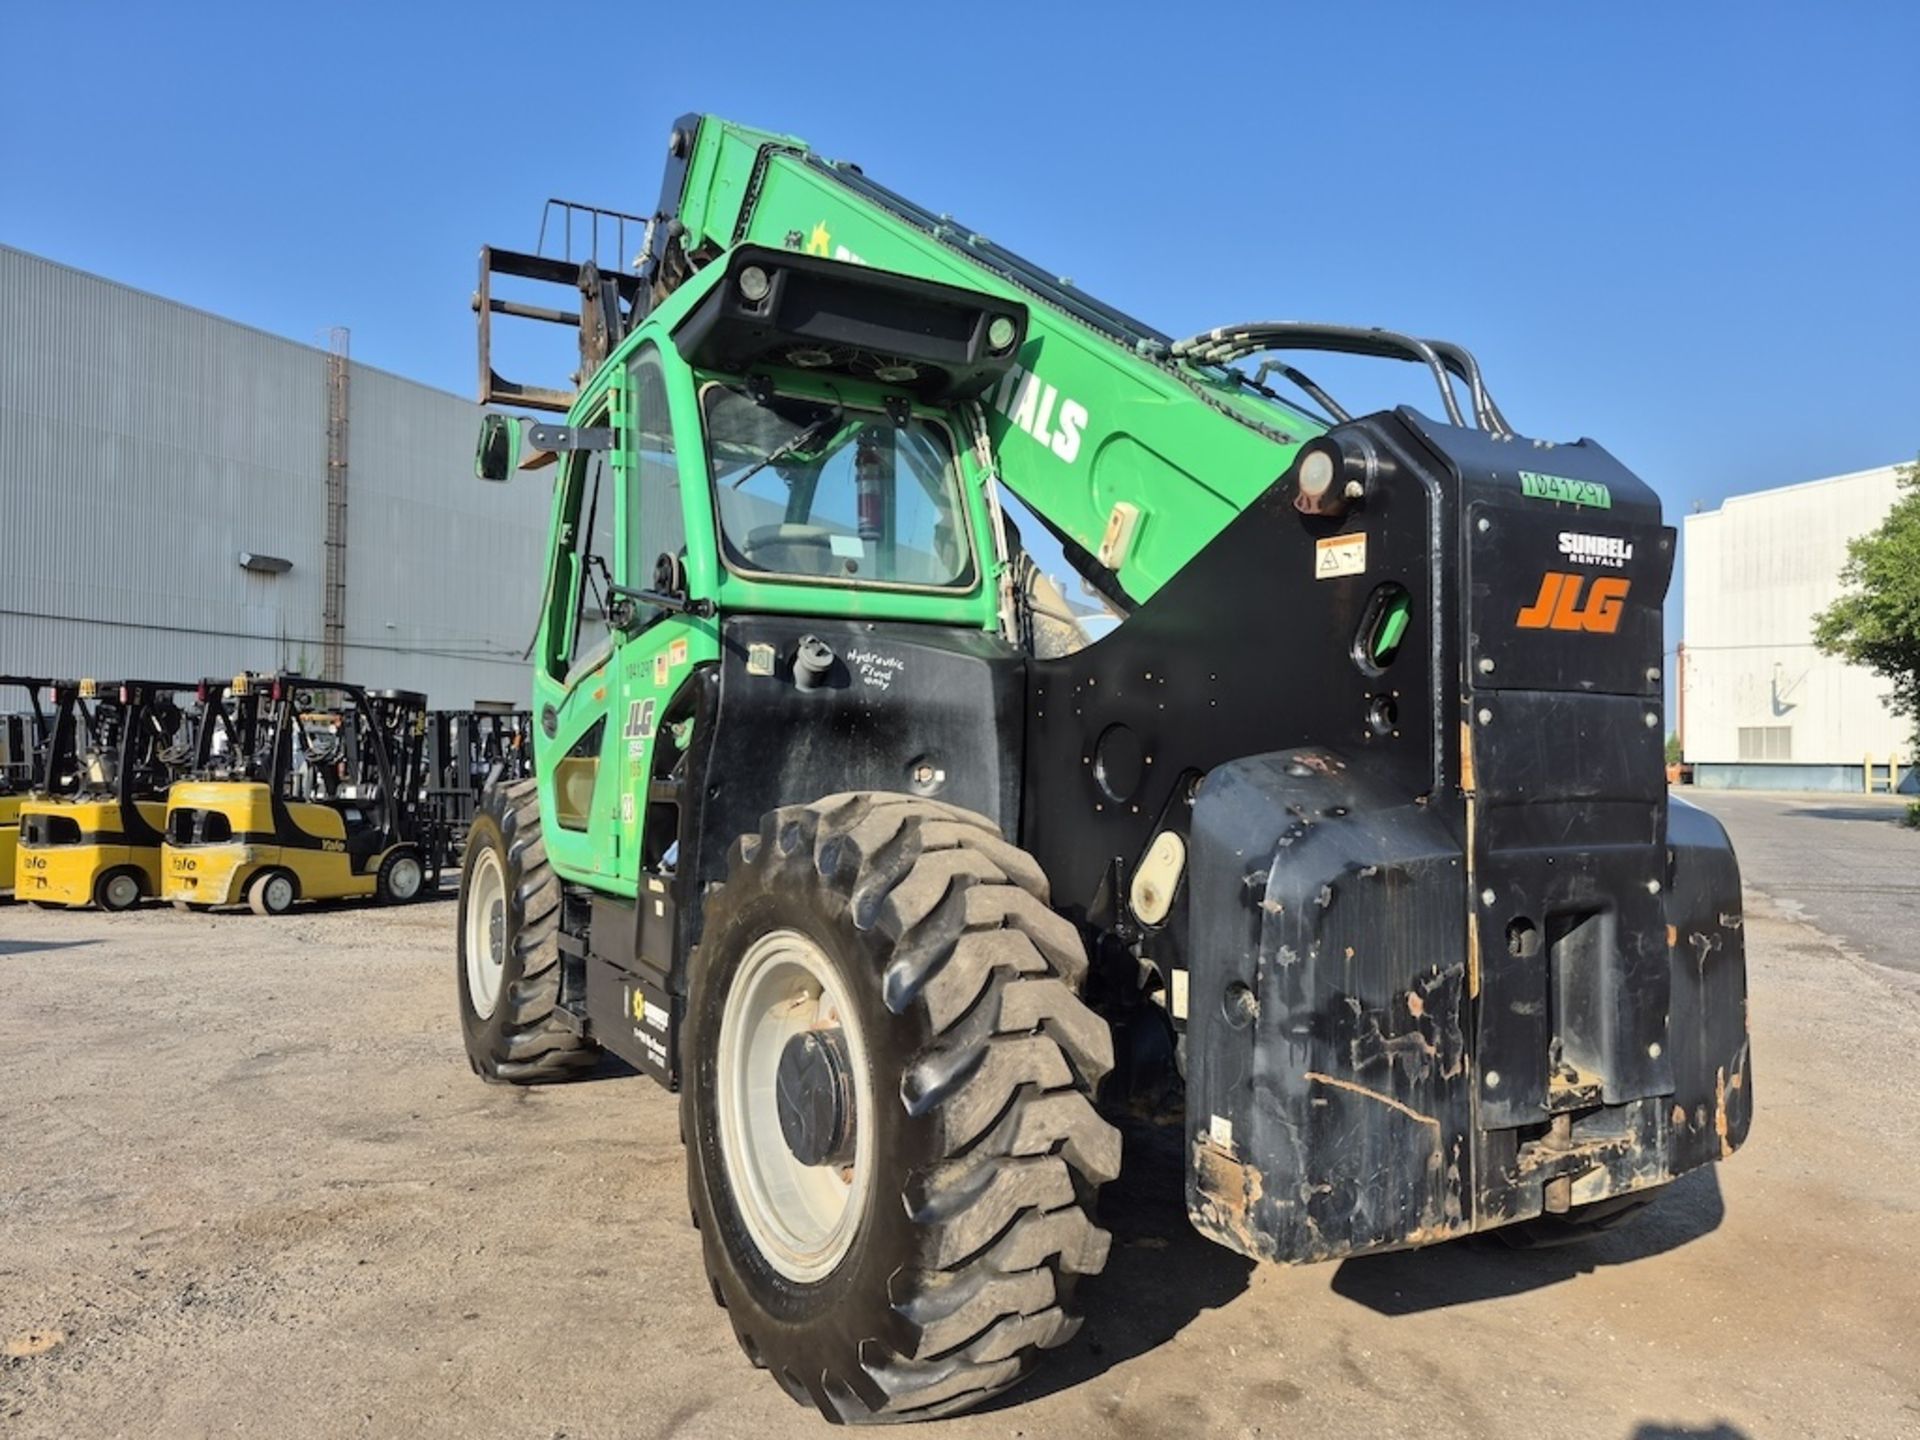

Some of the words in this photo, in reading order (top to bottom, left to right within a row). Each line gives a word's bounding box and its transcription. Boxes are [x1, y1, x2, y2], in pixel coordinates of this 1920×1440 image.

[980, 362, 1089, 464] TALS
[1569, 554, 1623, 568] RENTALS
[1516, 572, 1632, 634] JLG
[624, 699, 655, 738] JLG
